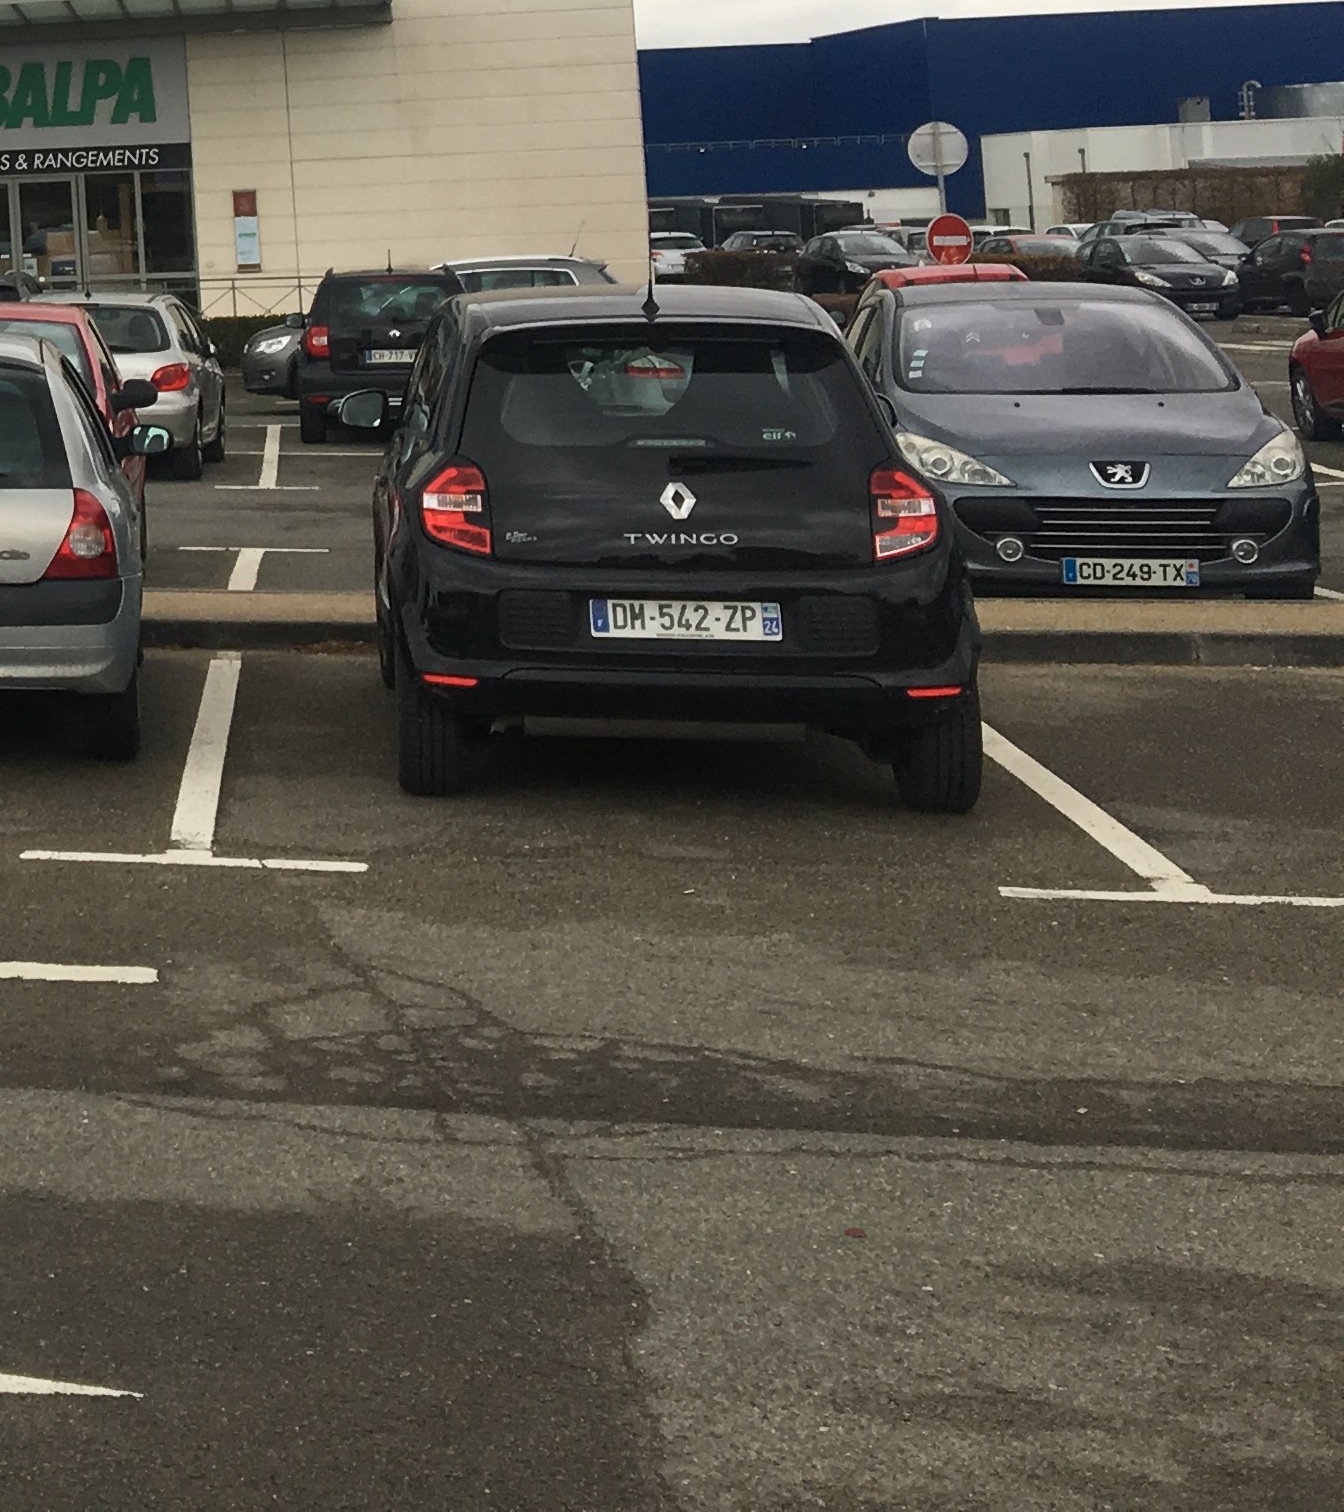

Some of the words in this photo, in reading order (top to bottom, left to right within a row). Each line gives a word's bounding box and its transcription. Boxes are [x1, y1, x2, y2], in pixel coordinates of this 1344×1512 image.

[15, 153, 29, 171] &
[33, 147, 160, 170] RANGEMENTS
[623, 533, 739, 545] TWINGO
[1078, 562, 1185, 582] CD-249-TX
[611, 602, 758, 633] DM-542-ZP
[763, 620, 779, 634] 24
